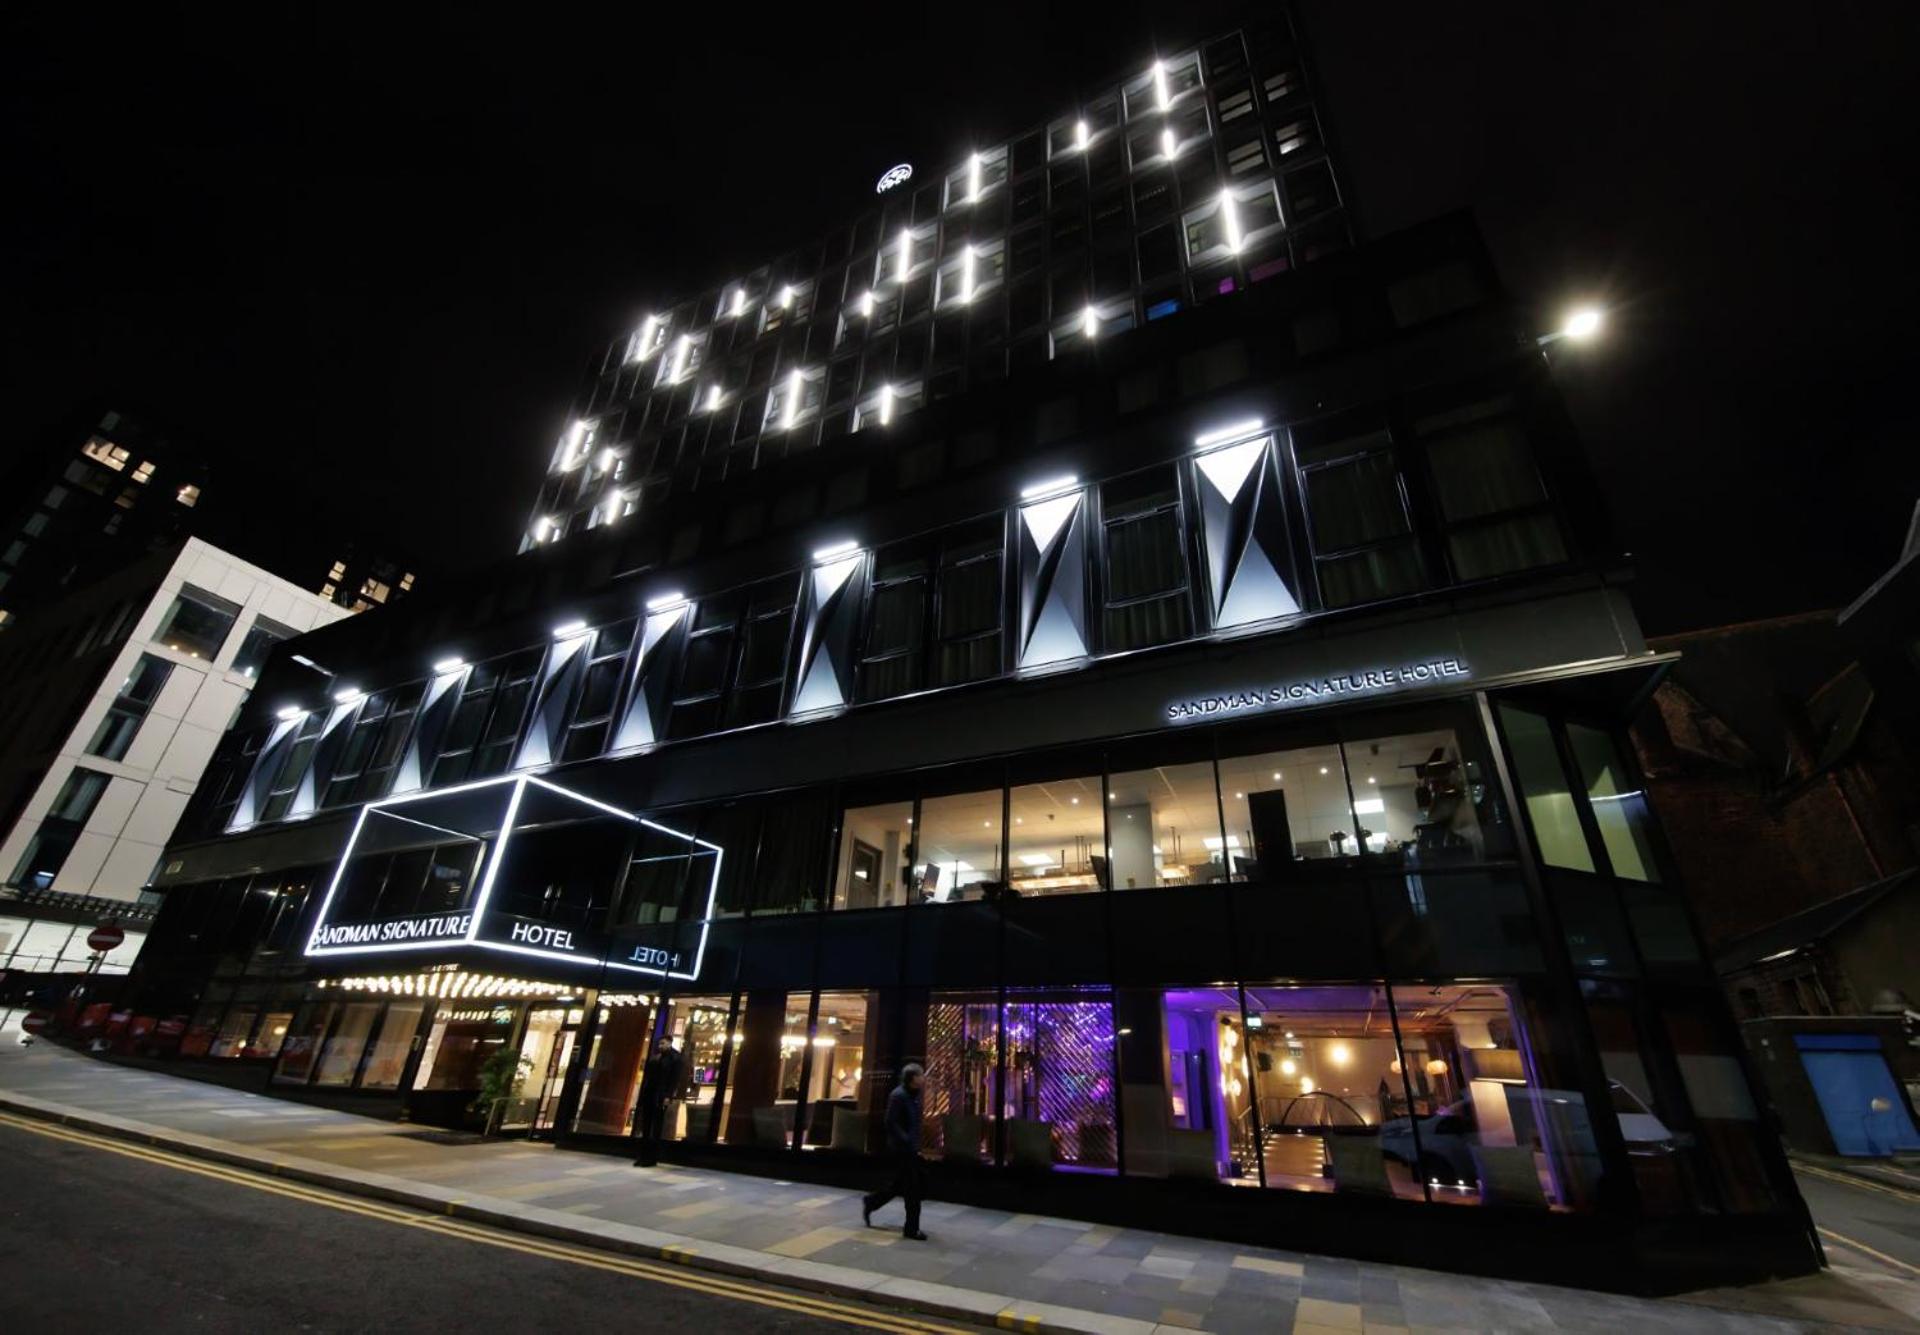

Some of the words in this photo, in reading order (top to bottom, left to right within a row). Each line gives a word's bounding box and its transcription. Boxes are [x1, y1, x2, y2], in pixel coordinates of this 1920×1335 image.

[1168, 690, 1265, 720] SANDMAN
[1270, 668, 1396, 702] SIGNATURE
[1399, 658, 1469, 682] HOTEL
[313, 924, 382, 945] SANDMAN
[382, 916, 470, 940] SIGNATURE
[512, 923, 574, 949] HOTEL
